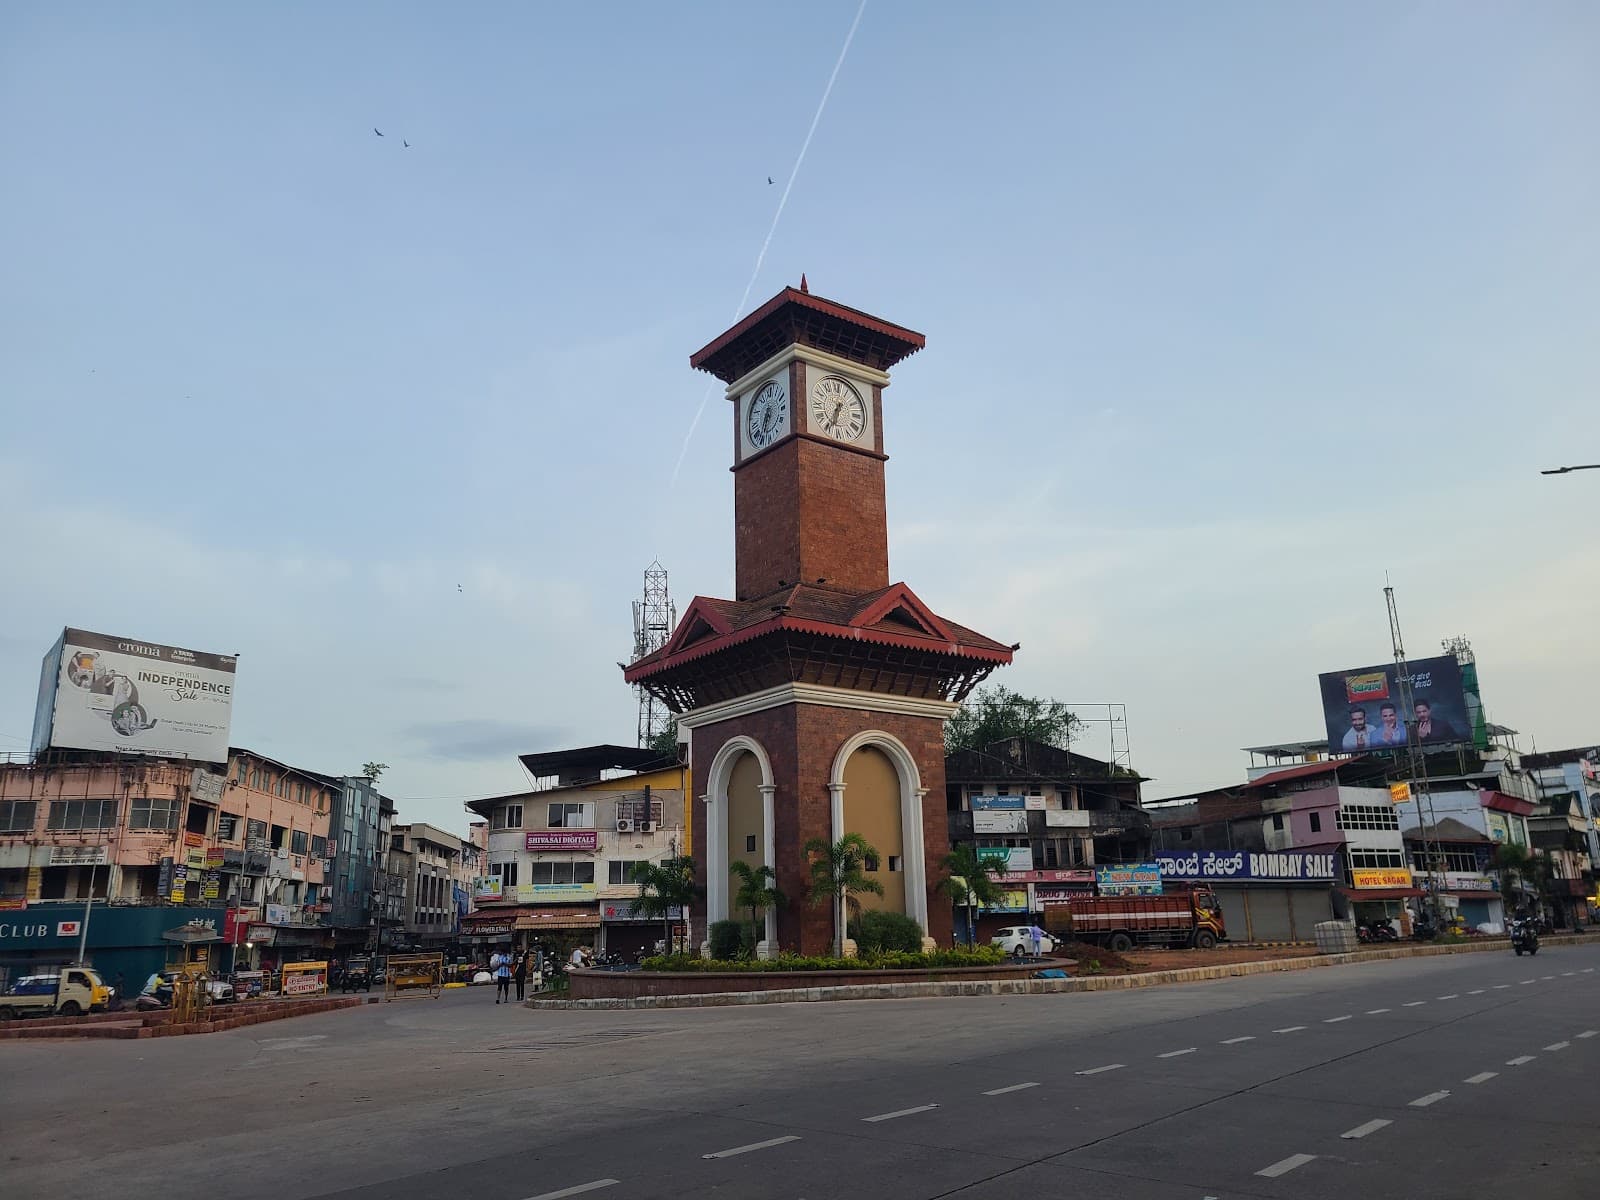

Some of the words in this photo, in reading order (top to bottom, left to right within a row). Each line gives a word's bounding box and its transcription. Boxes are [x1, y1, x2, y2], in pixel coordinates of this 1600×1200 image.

[138, 671, 231, 695] INDEPENDENCE
[170, 687, 199, 702] Sale
[1155, 852, 1199, 875] ಬಾಂಬೆ
[1202, 852, 1243, 875] ಸೇಲ್
[1250, 854, 1303, 877] BOMBAY
[1305, 855, 1335, 877] SALE
[1359, 877, 1381, 885] HOTEL
[1382, 876, 1406, 885] SAGAR
[1036, 889, 1060, 898] DRUG
[0, 923, 48, 938] CLUB
